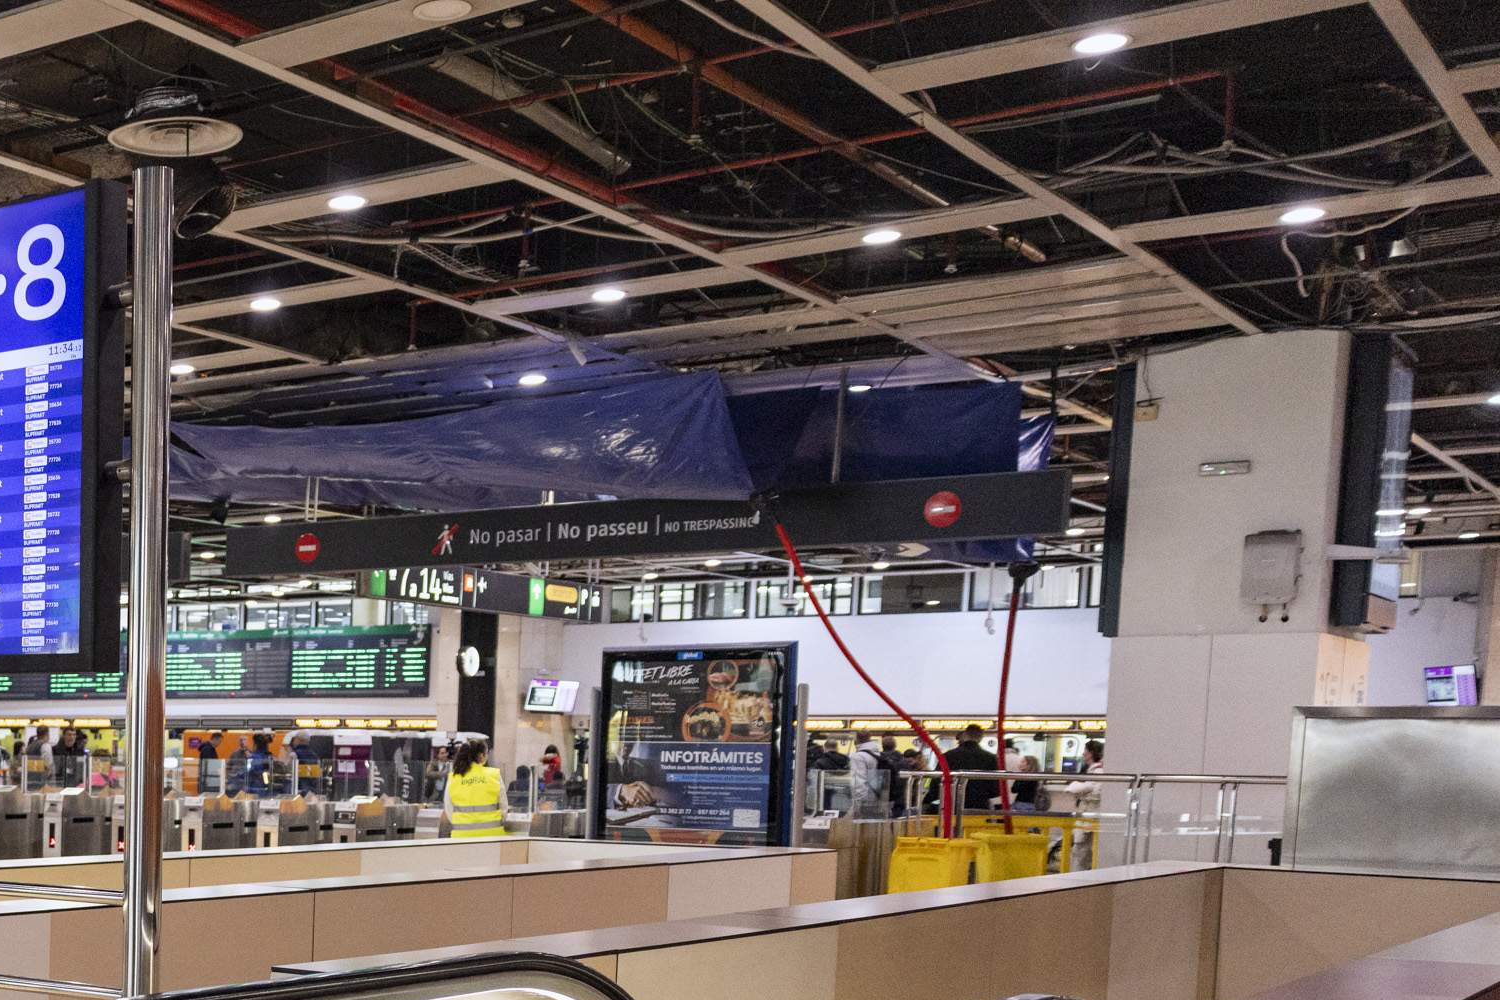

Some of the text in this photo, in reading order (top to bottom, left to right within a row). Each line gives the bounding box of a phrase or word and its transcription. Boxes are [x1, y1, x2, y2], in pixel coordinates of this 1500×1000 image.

[470, 528, 490, 544] No
[496, 527, 542, 547] pasar
[558, 523, 580, 539] No
[587, 520, 648, 542] passeu
[664, 522, 680, 532] NO
[419, 568, 442, 601] 14
[659, 664, 694, 679] LIBRE
[660, 748, 764, 764] INFOTRÁMITES
